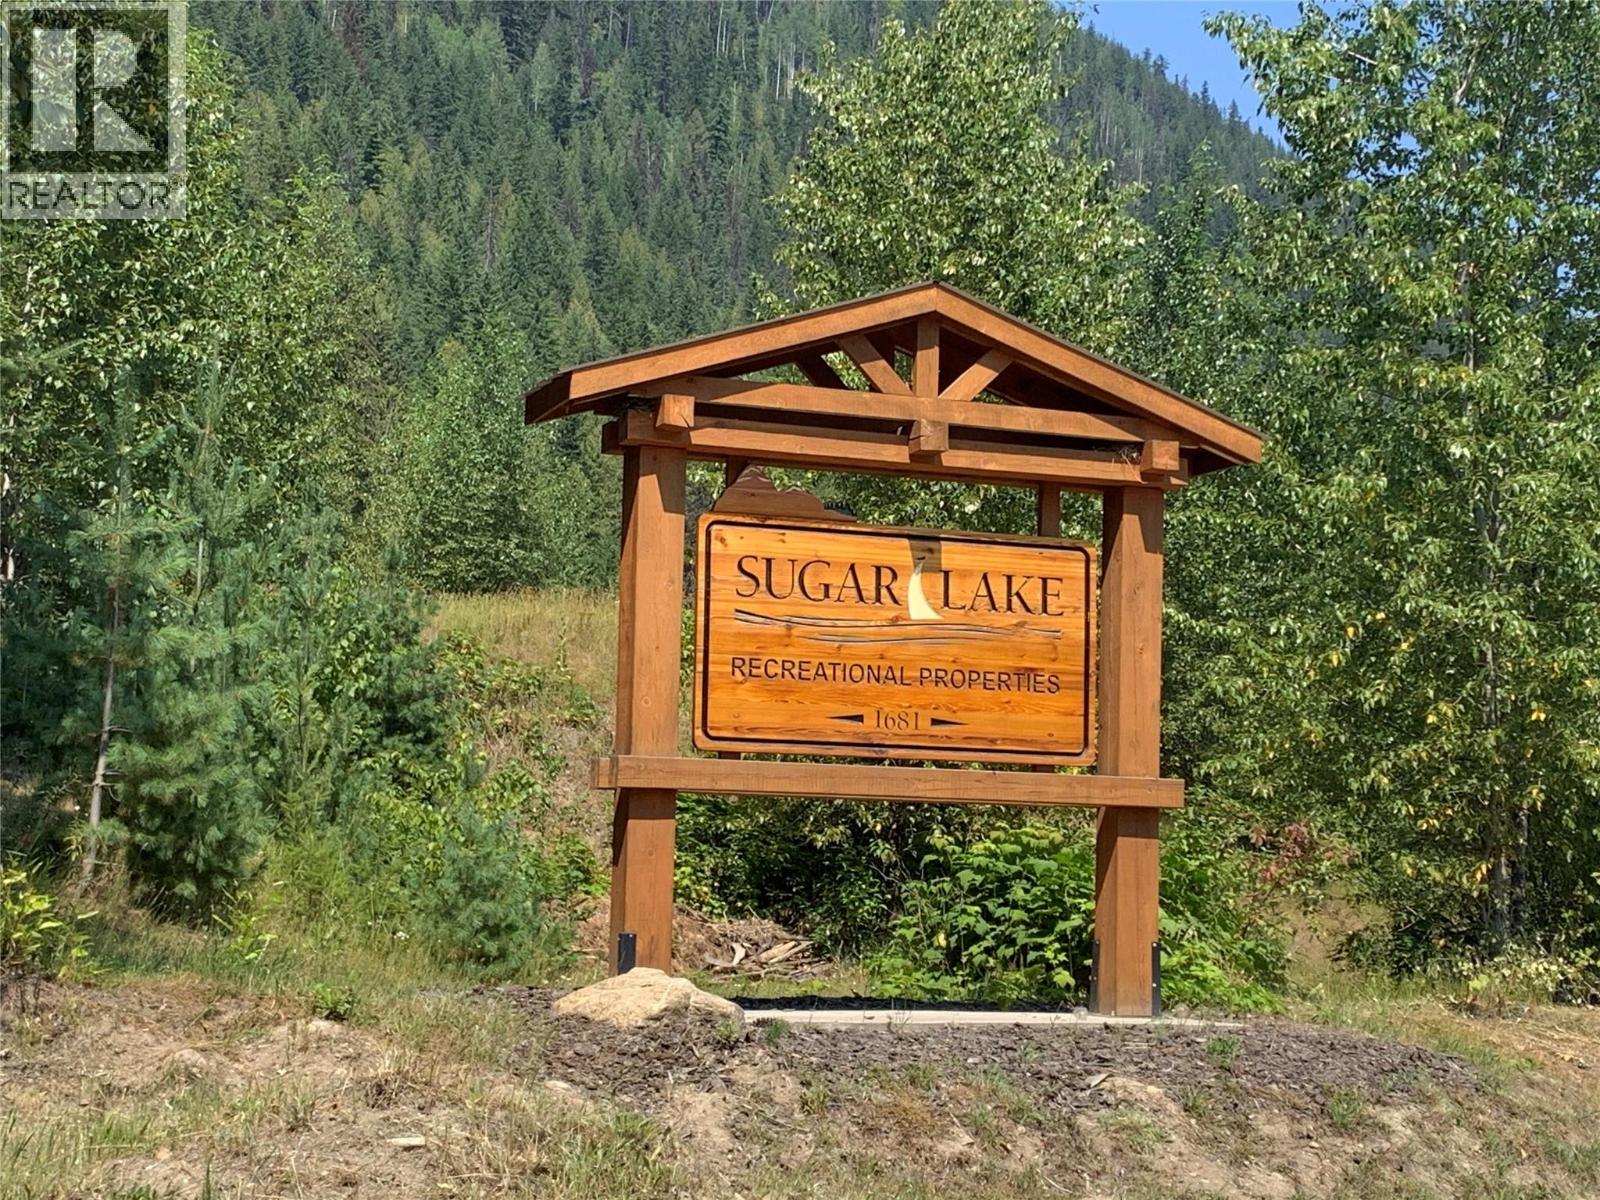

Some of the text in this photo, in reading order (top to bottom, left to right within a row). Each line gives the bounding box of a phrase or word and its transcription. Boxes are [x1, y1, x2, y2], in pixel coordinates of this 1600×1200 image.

[735, 555, 1064, 617] SUGAR LAKE
[731, 657, 1061, 694] RECREATIONAL PROPERTIES
[874, 710, 920, 731] 1681
